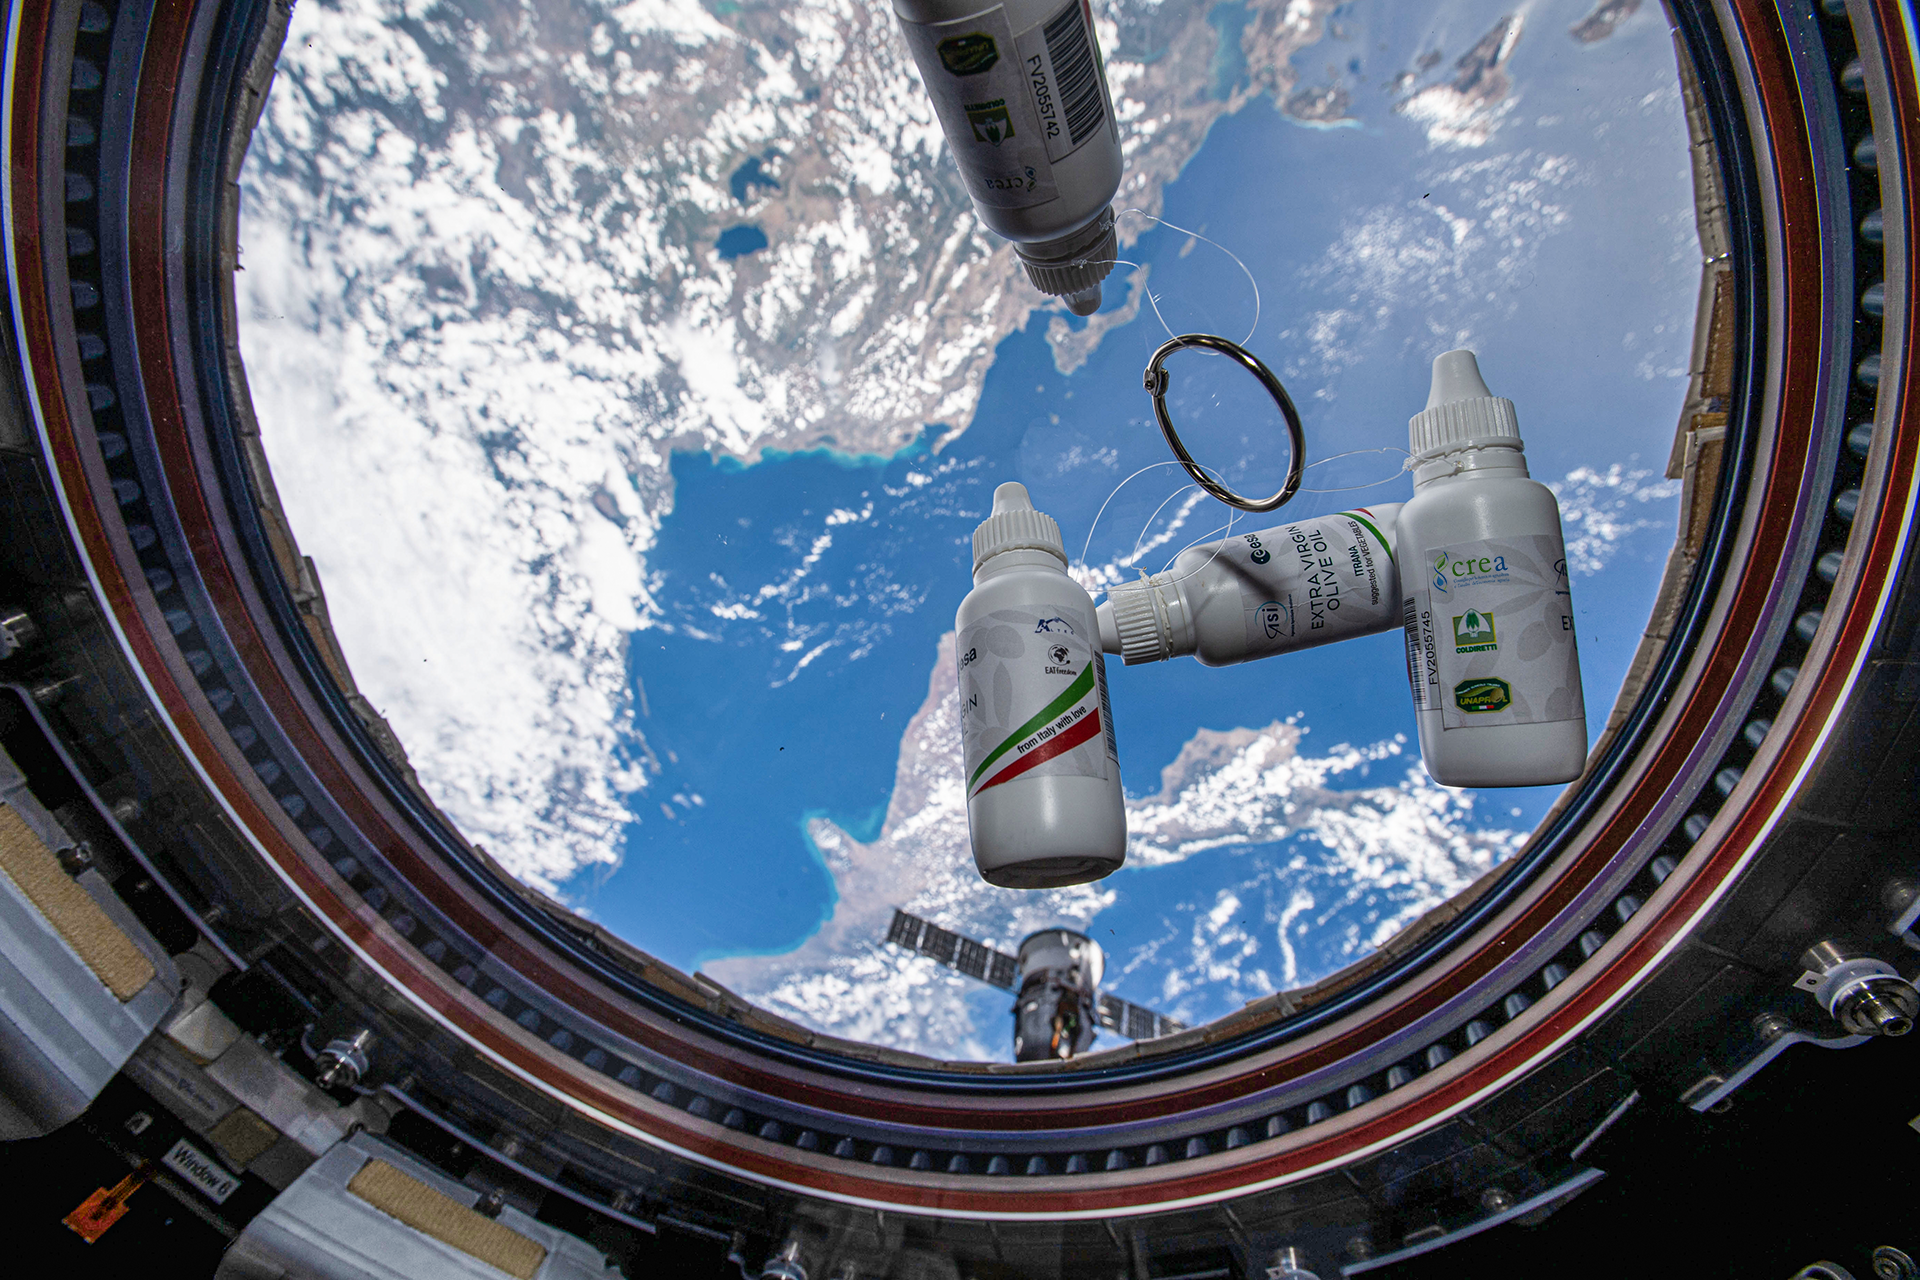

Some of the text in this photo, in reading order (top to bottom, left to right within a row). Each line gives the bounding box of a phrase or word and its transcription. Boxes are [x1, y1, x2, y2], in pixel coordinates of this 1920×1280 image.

[1026, 54, 1060, 140] FV2055742
[986, 177, 1024, 192] crea
[1284, 525, 1325, 630] EXTRA VIRGIN
[1308, 529, 1341, 611] OLIVE OIL
[1348, 545, 1364, 577] ITRANA
[1348, 520, 1379, 606] suggested for VEGETABLES
[1452, 555, 1509, 577] crea
[1420, 610, 1438, 685] FV2055745
[1456, 644, 1498, 654] COLDIRETTI
[1017, 704, 1087, 754] from Italy with love
[172, 1145, 219, 1188] Window
